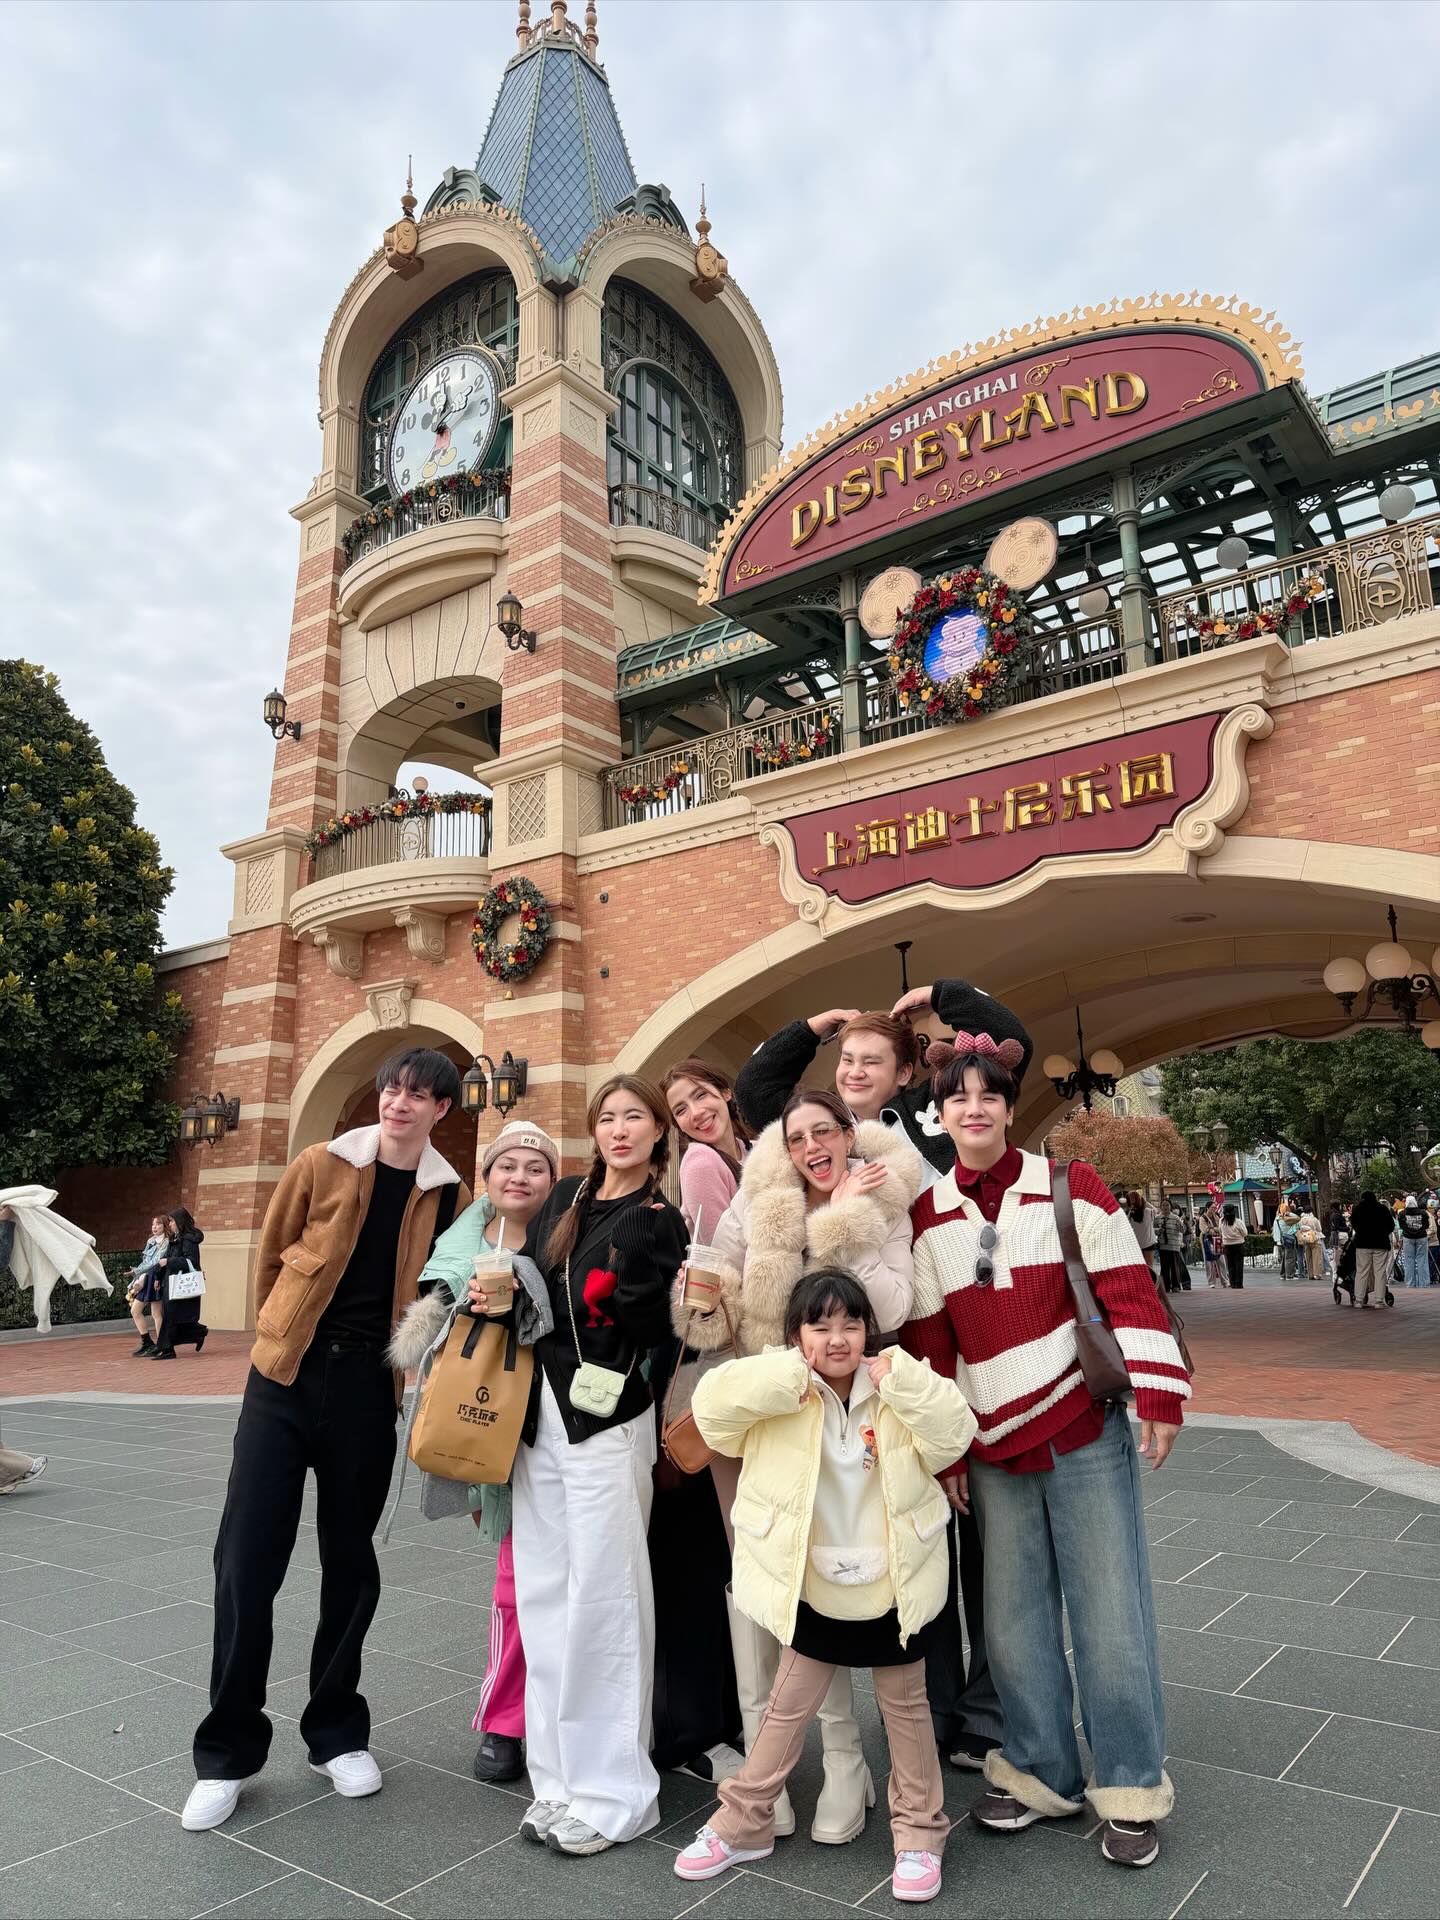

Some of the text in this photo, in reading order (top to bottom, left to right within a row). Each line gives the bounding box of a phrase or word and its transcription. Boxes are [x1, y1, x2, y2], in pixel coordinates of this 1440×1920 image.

[474, 374, 485, 393] 2
[418, 384, 429, 404] 11
[479, 398, 490, 417] 3
[888, 373, 1019, 442] SHANGHAI
[402, 413, 417, 435] 10
[472, 429, 484, 447] 4
[396, 446, 405, 463] 9
[789, 371, 1149, 550] DISNEYLAND
[401, 468, 411, 486] 8
[811, 751, 1179, 876] 上海迪士尼乐园
[457, 1403, 499, 1423] 巧克玩家
